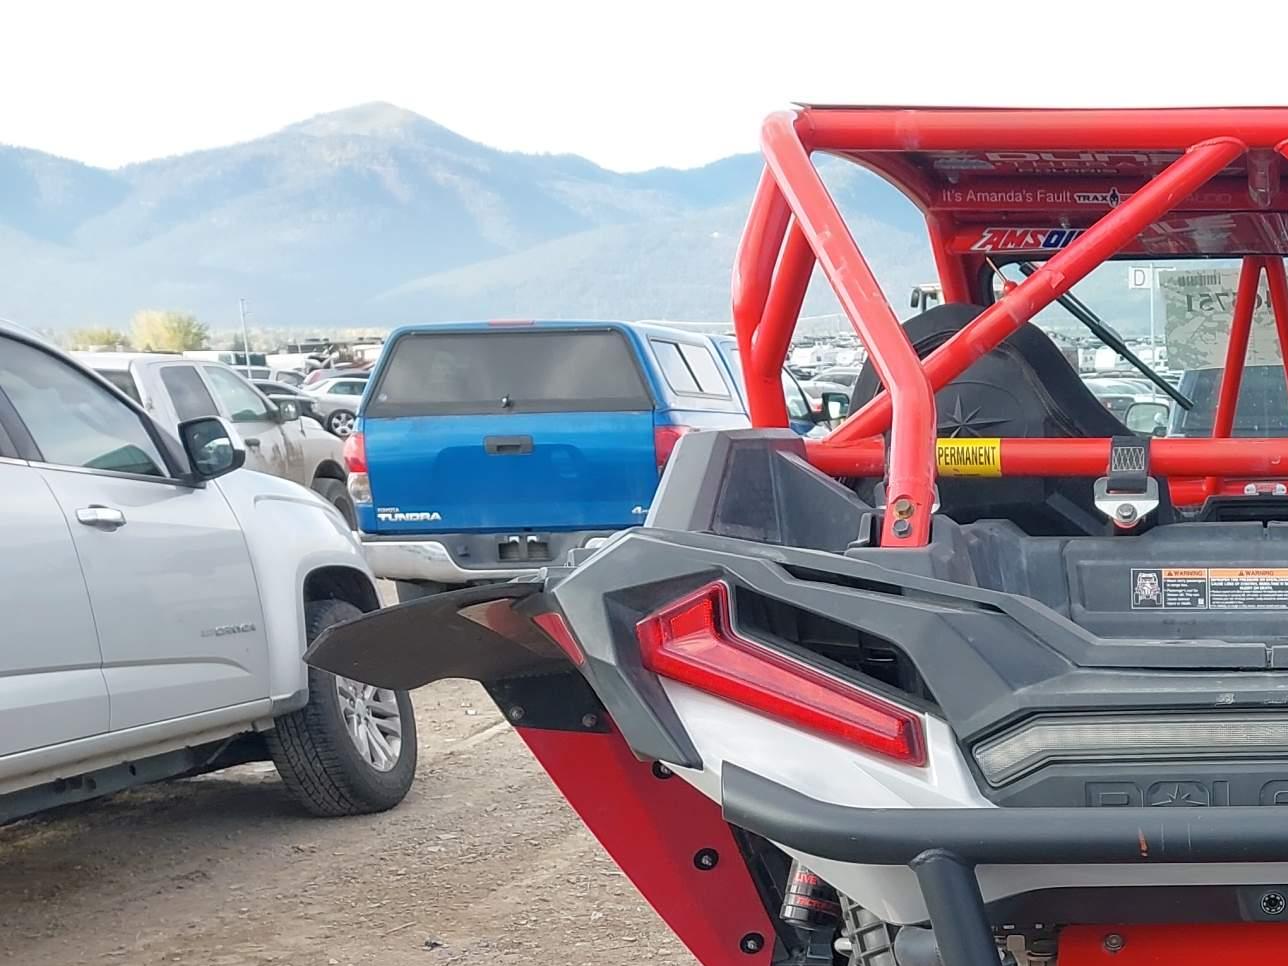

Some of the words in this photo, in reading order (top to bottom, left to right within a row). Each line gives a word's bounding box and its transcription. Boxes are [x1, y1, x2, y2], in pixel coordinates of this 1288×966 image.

[943, 189, 962, 202] It's
[967, 189, 1033, 203] Amanda's
[1037, 189, 1071, 202] Fault
[1133, 269, 1146, 287] D
[937, 446, 996, 466] PERMANENT
[377, 512, 442, 521] TUNDRA
